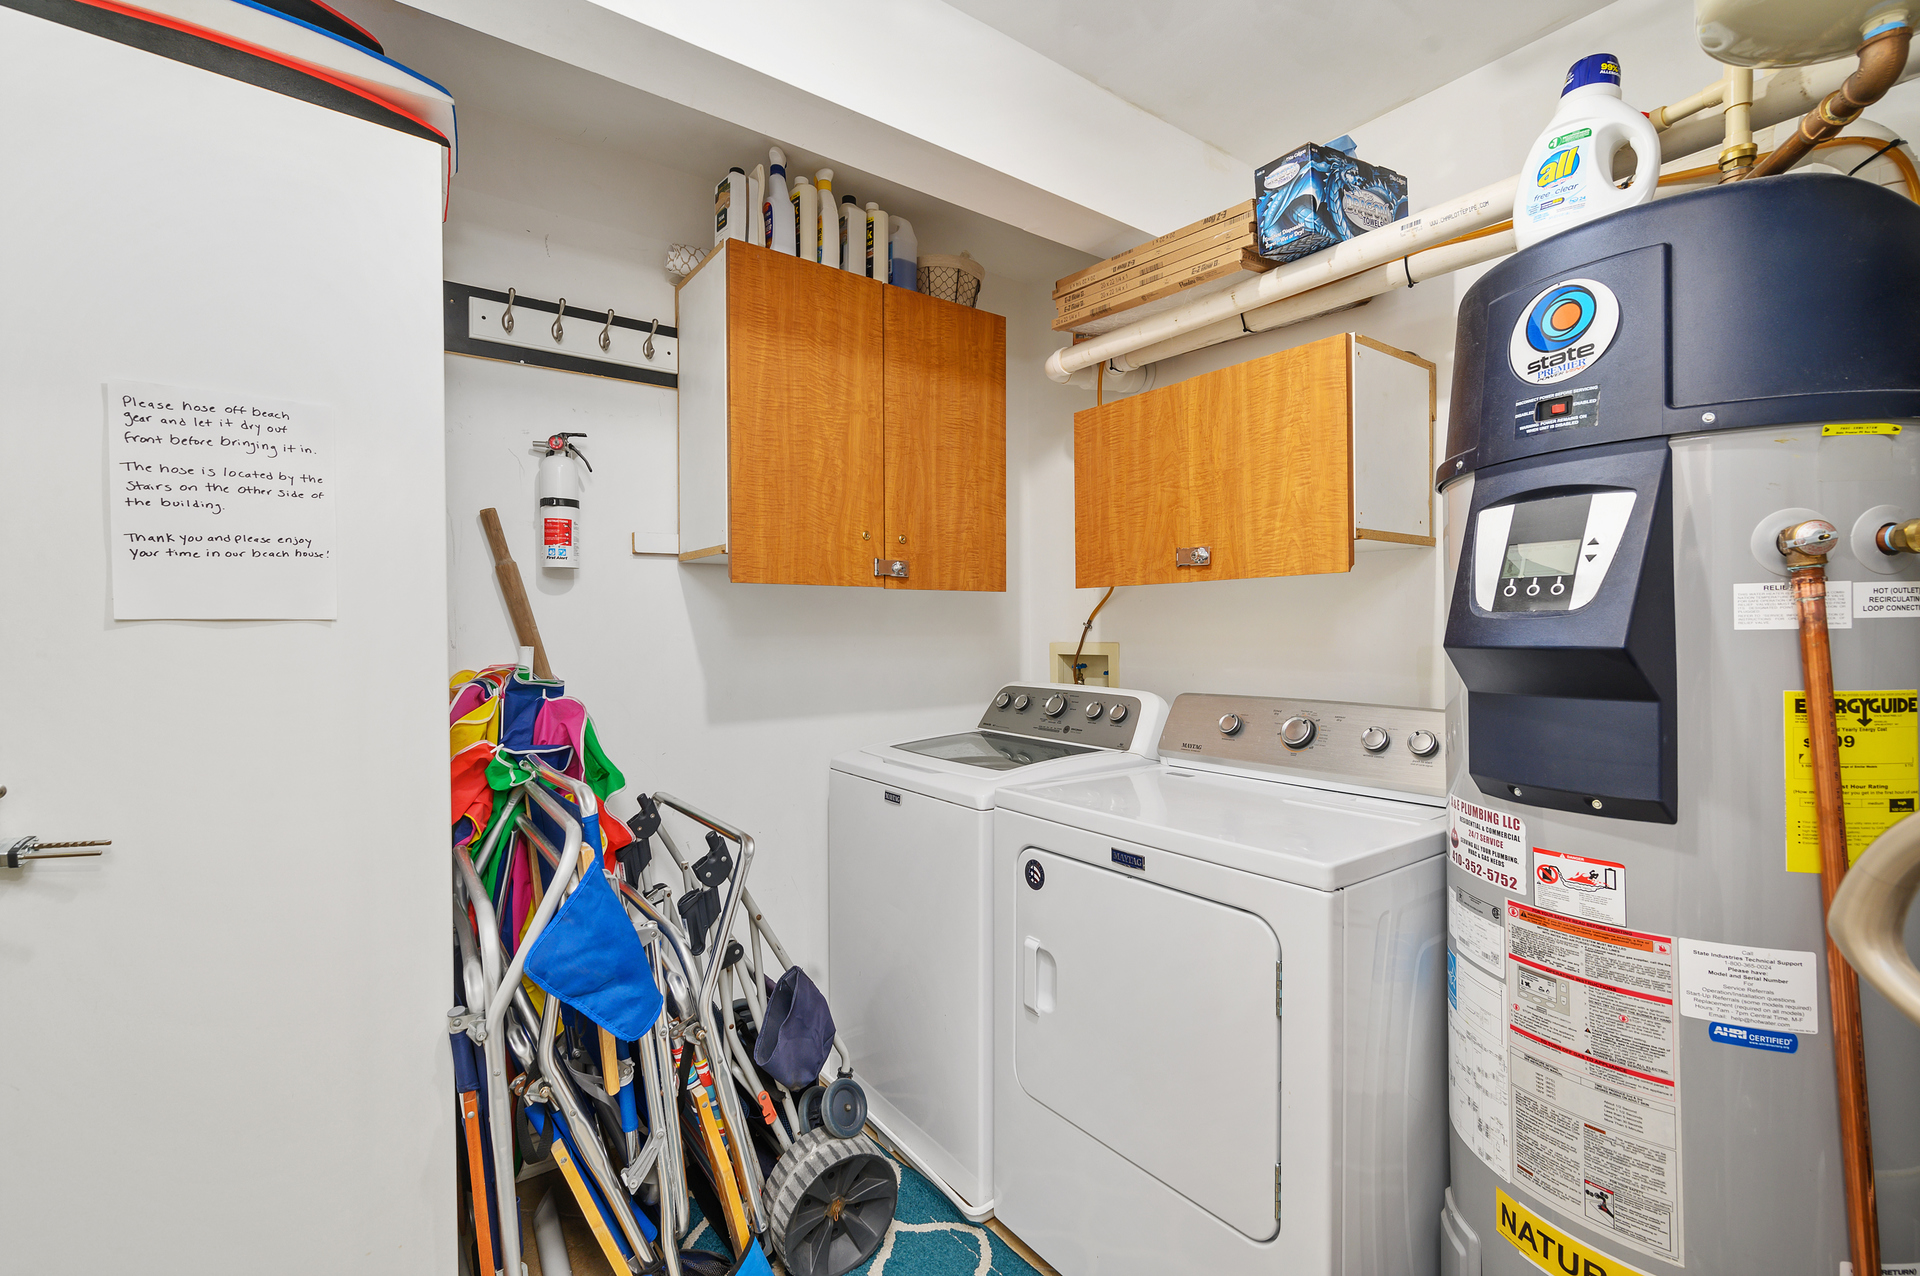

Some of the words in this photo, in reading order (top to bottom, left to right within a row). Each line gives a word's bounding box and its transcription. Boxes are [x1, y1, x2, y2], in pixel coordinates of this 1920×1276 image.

[1538, 146, 1579, 187] all
[1534, 192, 1551, 201] free
[1555, 184, 1579, 194] clear
[1345, 194, 1389, 223] DRAGON
[1363, 217, 1383, 227] TOWELS
[1527, 343, 1594, 375] state
[1538, 359, 1586, 379] PREMIER
[1573, 385, 1598, 393] SERVICING
[122, 395, 173, 411] Please
[182, 401, 216, 413] hose
[225, 405, 246, 414] off
[252, 407, 290, 420] beach
[124, 412, 152, 426] gear
[160, 417, 186, 426] and
[194, 417, 212, 427] let
[219, 419, 233, 427] it
[240, 420, 261, 435] dry
[267, 425, 287, 433] out
[124, 432, 162, 444] front
[170, 434, 213, 447] before
[220, 436, 278, 458] bringing
[300, 445, 316, 454] in.
[119, 461, 152, 473] The
[159, 464, 195, 475] hose
[202, 467, 216, 477] is
[224, 468, 273, 480] located
[278, 472, 294, 485] by
[300, 474, 323, 484] the
[180, 484, 197, 492] on
[205, 482, 229, 494] the
[125, 498, 151, 506] the
[161, 498, 225, 515] building.
[124, 532, 174, 543] Thank
[179, 535, 202, 545] you
[207, 534, 231, 543] and
[234, 536, 271, 545] please
[277, 536, 312, 548] enjoy
[166, 548, 200, 558] time
[206, 549, 220, 557] in
[252, 549, 289, 558] beach
[295, 549, 330, 559] house!
[1795, 698, 1917, 713] ERGYGUIDE
[1182, 742, 1202, 750] MAYTAG
[1461, 802, 1500, 825] PLUMBING
[1503, 815, 1520, 831] LLC
[1460, 816, 1481, 830] RESIDENTIAL
[1486, 826, 1520, 842] COMMERCIAL
[1461, 836, 1473, 848] SERVING
[1480, 846, 1491, 855] YOUR
[1468, 830, 1479, 839] 24/7
[1480, 834, 1504, 849] SERVICE
[1112, 851, 1142, 868] MAYTAG
[1468, 848, 1477, 858] HVAC
[1482, 854, 1490, 862] GAS
[1490, 857, 1504, 868] NEEDS
[1452, 850, 1518, 890] 410-352-5752
[1554, 914, 1571, 922] SAFETY
[1608, 927, 1632, 936] LIGHTING
[1711, 952, 1743, 960] Industries
[1746, 956, 1775, 964] Technical
[1725, 960, 1772, 970] 1-800-365-0024
[1546, 968, 1574, 980] OPERATING
[1576, 977, 1616, 992] INSTRUCTIONS
[1686, 990, 1710, 999] Start-Up
[1712, 995, 1740, 1003] Referrals
[1702, 986, 1765, 1000] Operation/Installation
[1694, 997, 1733, 1008] Replacement
[1734, 1005, 1762, 1013] (required
[1731, 1015, 1790, 1027] help@hotwater.com
[1714, 1026, 1747, 1039] AHRI
[1548, 1042, 1561, 1050] TURN
[1573, 1051, 1585, 1059] GAS
[1595, 1058, 1627, 1073] APPLIANCE
[1502, 1202, 1608, 1276] NATUR
